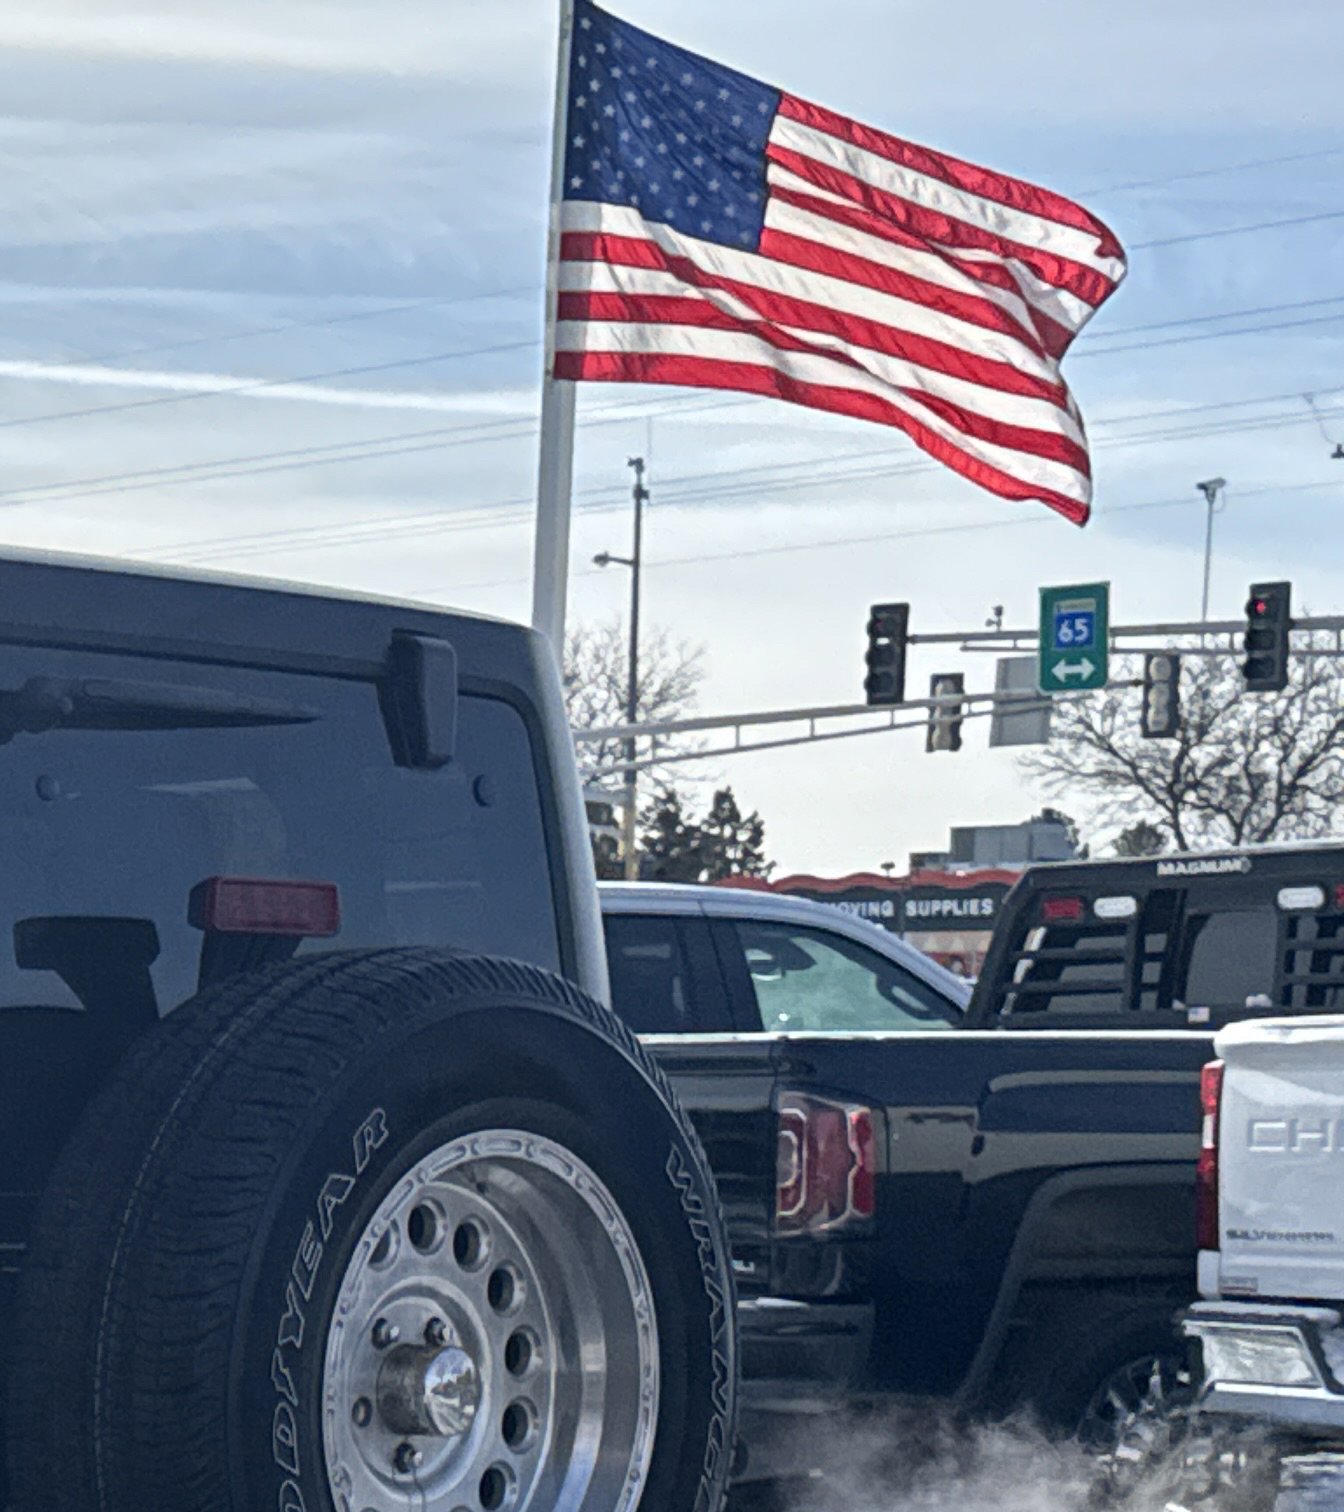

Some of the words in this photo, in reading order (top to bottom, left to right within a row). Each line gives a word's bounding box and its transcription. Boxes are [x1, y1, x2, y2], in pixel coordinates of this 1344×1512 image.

[1058, 618, 1089, 643] 65
[1156, 859, 1244, 877] MAGNUM
[905, 898, 994, 917] SUPPLIES
